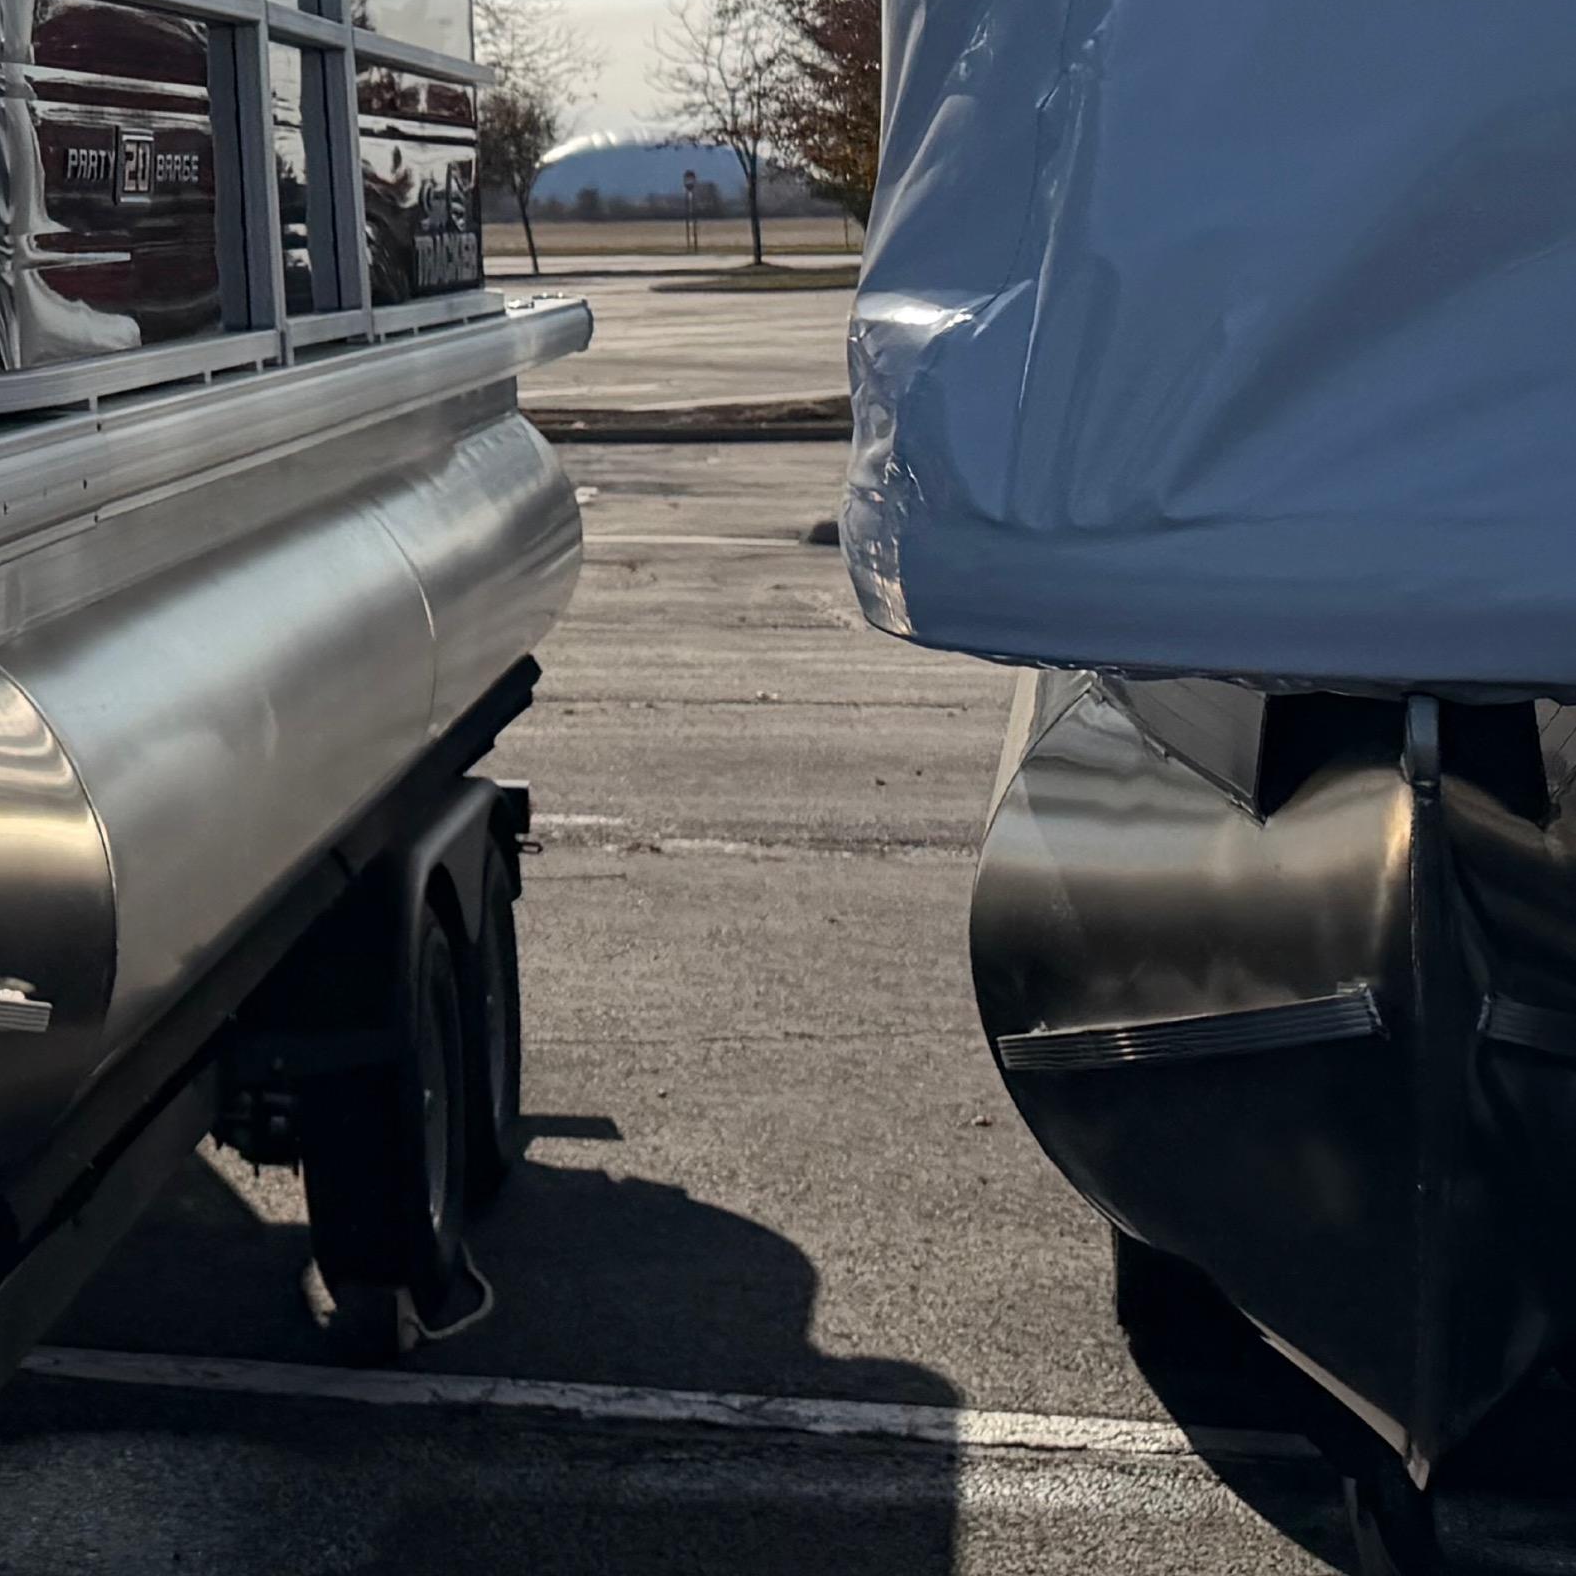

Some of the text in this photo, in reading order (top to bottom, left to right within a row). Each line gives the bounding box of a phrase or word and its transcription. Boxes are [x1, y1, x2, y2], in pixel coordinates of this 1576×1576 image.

[66, 142, 200, 192] PARTY 20 BARGE
